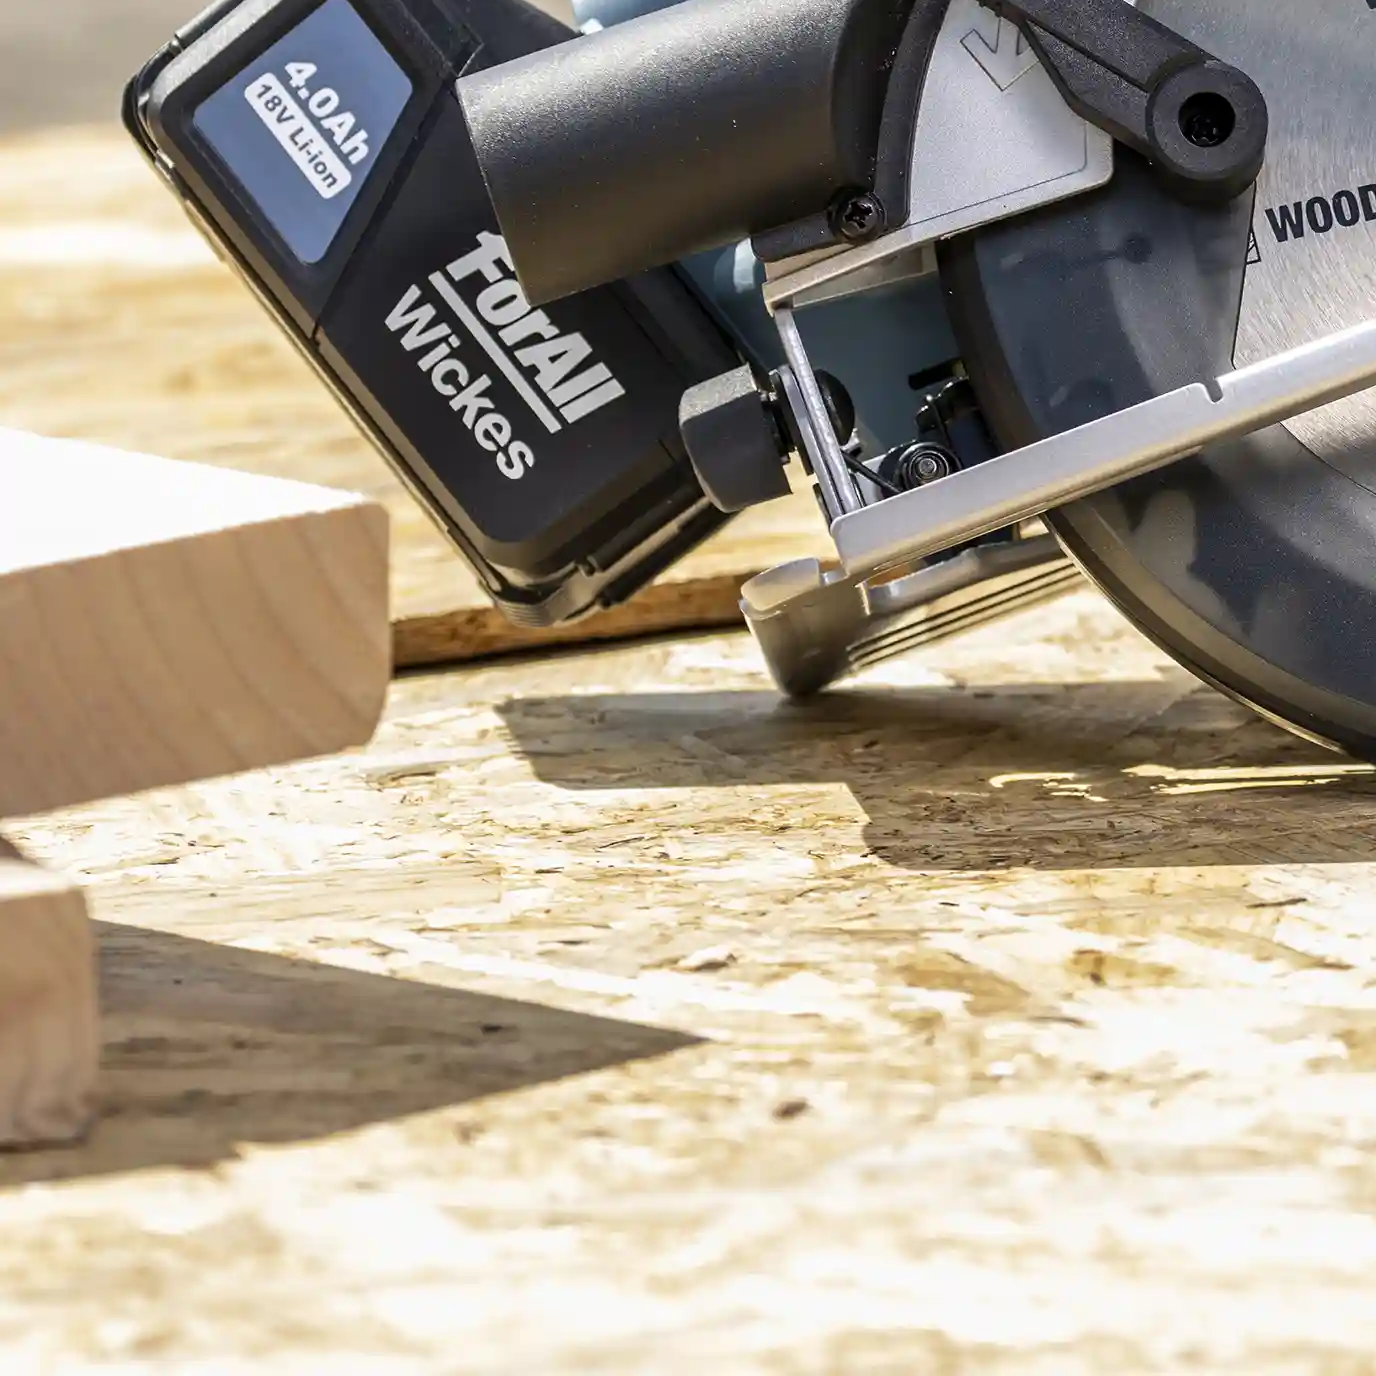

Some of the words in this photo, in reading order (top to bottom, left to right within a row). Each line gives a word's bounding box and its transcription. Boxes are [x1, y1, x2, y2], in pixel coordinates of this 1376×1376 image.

[255, 83, 296, 125] 18V
[287, 126, 339, 189] Li-ion
[284, 61, 370, 165] 4.0Ah
[384, 283, 535, 480] Wickes
[445, 230, 626, 425] ForAll
